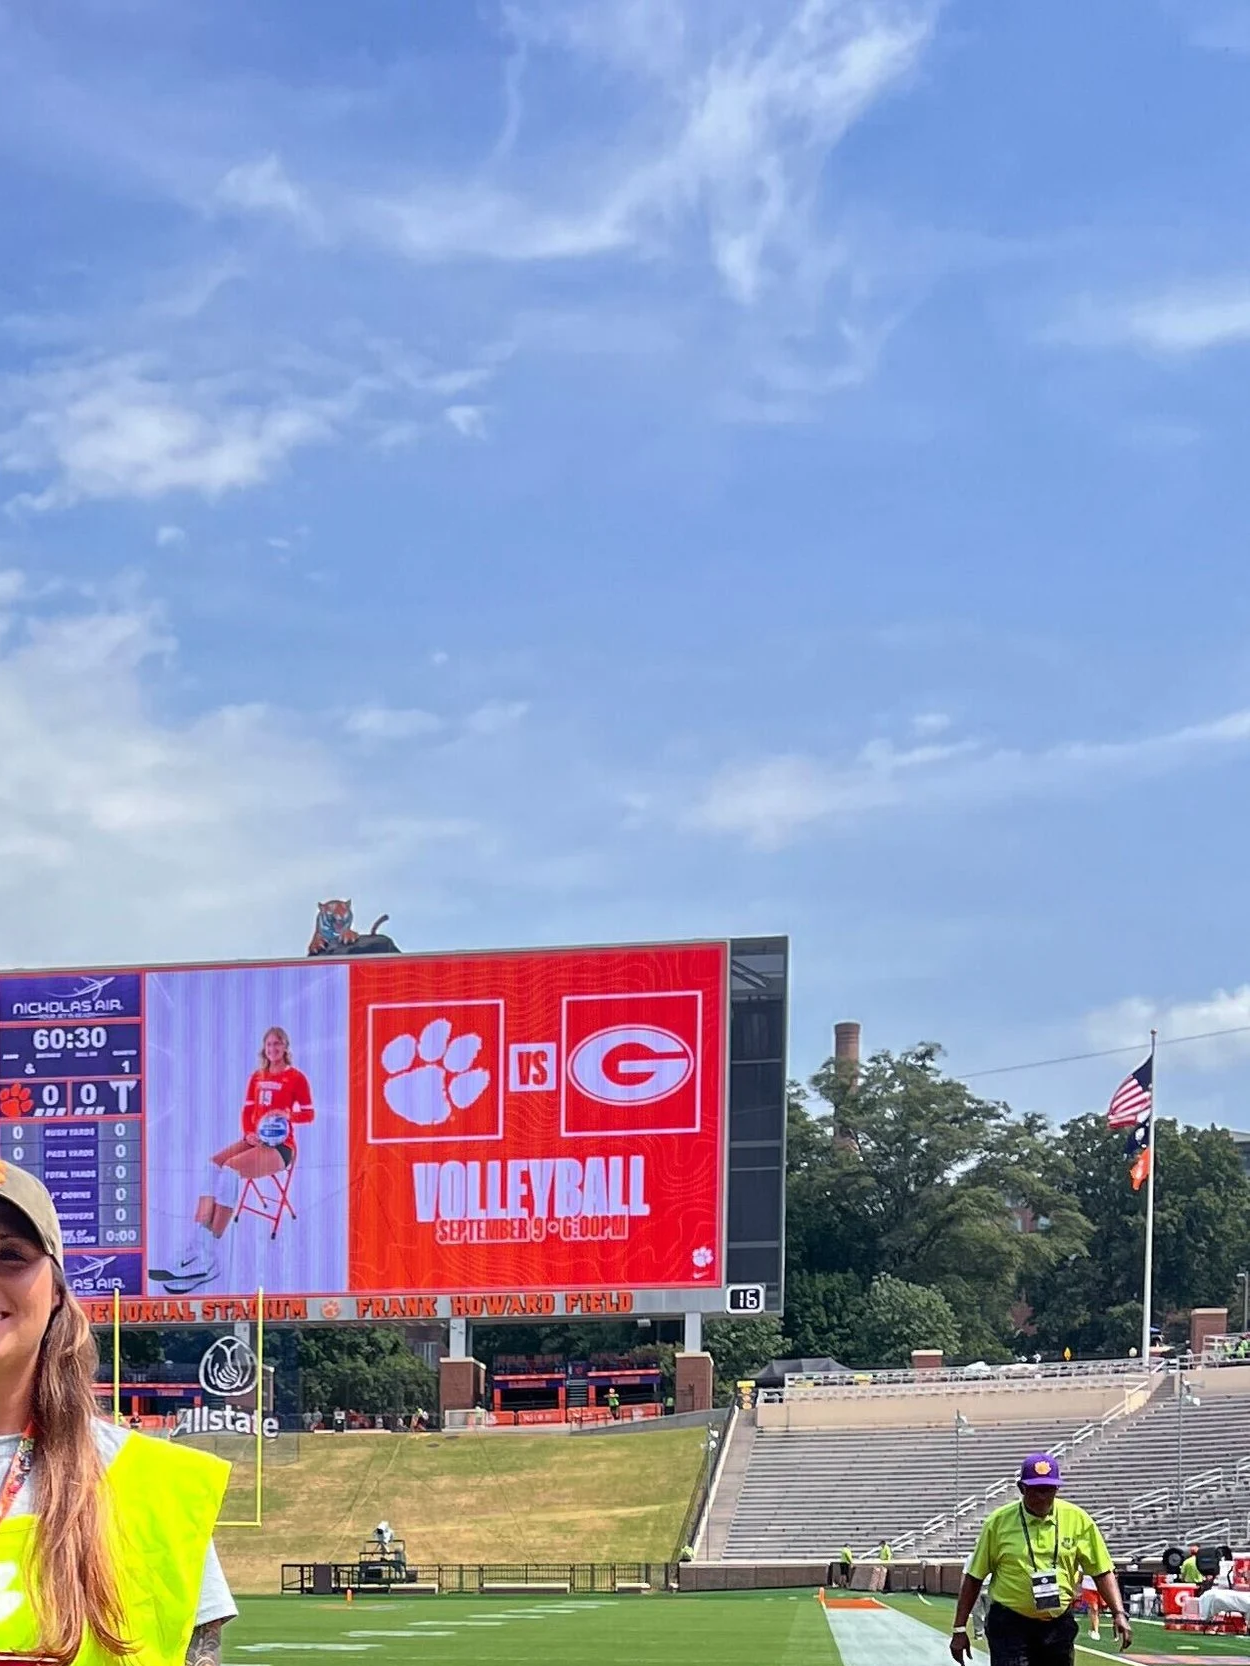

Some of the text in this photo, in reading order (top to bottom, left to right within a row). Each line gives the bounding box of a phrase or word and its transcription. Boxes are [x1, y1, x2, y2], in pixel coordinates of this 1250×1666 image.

[13, 999, 121, 1015] NICHOLAS AIR
[33, 1027, 107, 1050] 60:30
[24, 1063, 36, 1075] &
[121, 1060, 130, 1073] 1
[518, 1051, 548, 1086] VS
[573, 1029, 689, 1101] G
[42, 1085, 59, 1105] 0
[80, 1083, 97, 1104] 0
[12, 1126, 24, 1140] 0
[114, 1123, 126, 1137] 0
[12, 1147, 25, 1161] 0
[115, 1144, 126, 1158] 0
[115, 1165, 126, 1179] 0
[115, 1187, 126, 1201] 0
[413, 1156, 650, 1222] VOLLEYBALL
[115, 1208, 126, 1222] 0
[105, 1230, 137, 1242] 0:00
[437, 1214, 628, 1243] SEPTEMBER 9 6:00PM
[356, 1292, 633, 1318] FRANK HOWARD FIELD
[740, 1290, 758, 1308] 16
[202, 1299, 307, 1320] STADIUM
[171, 1404, 280, 1438] Allstate
